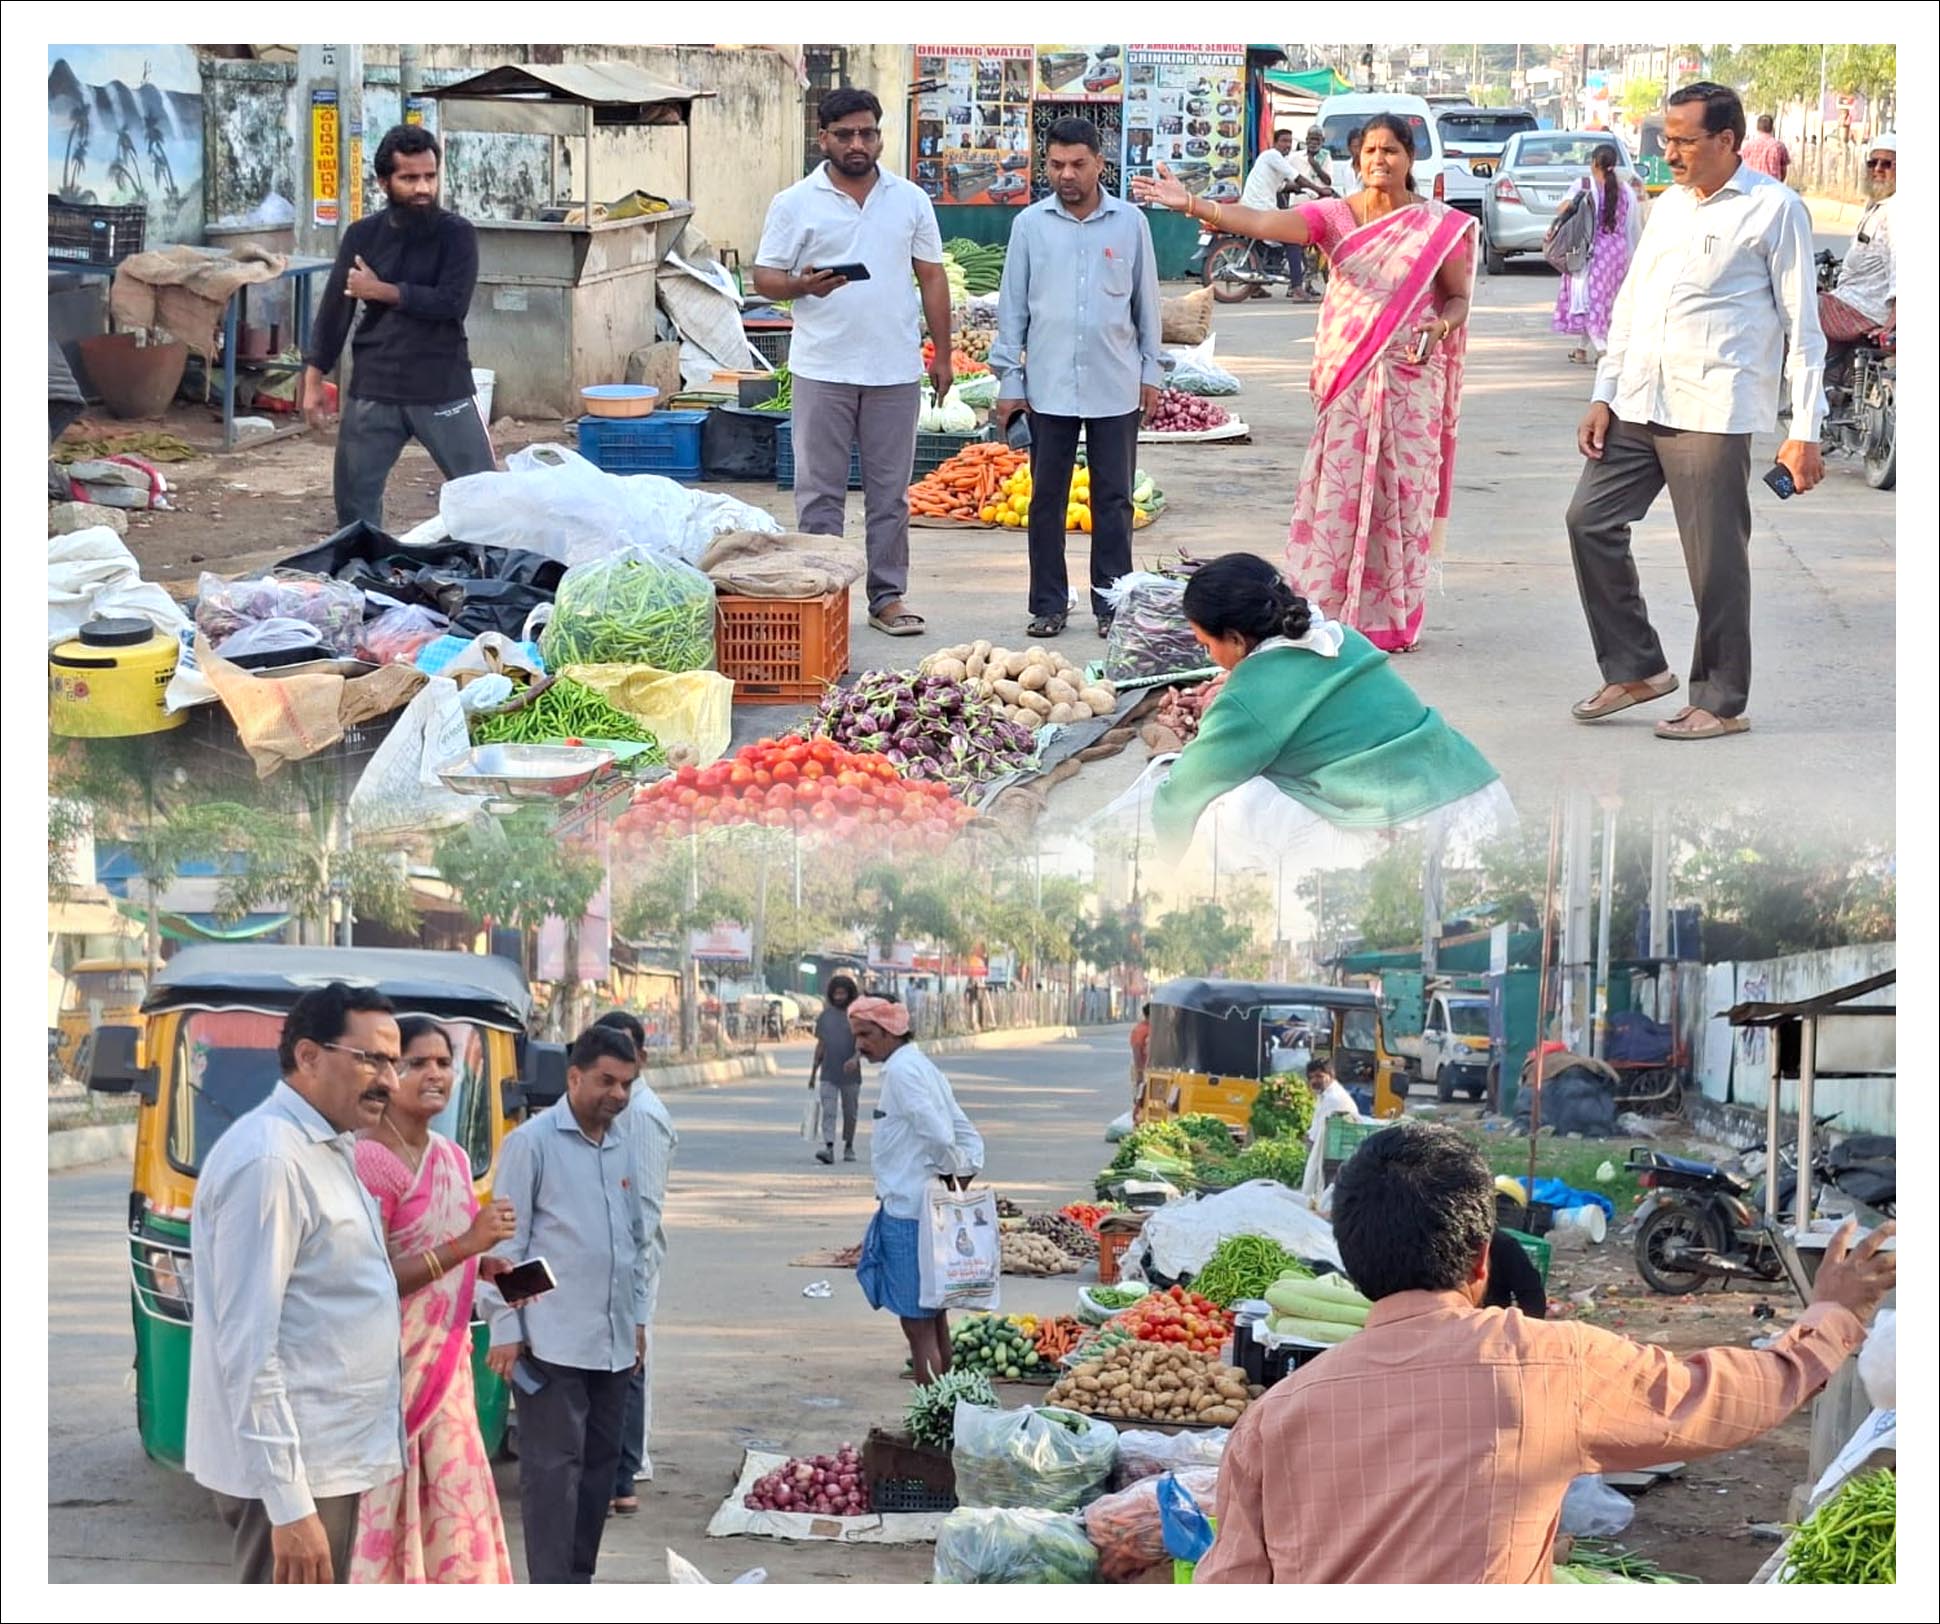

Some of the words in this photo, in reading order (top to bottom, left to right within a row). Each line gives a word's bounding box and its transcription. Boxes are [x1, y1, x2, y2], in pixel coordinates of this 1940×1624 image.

[917, 46, 983, 56] DRINKING
[986, 47, 1032, 57] WATER
[1128, 52, 1195, 64] DRINKING
[1197, 53, 1244, 65] WATER
